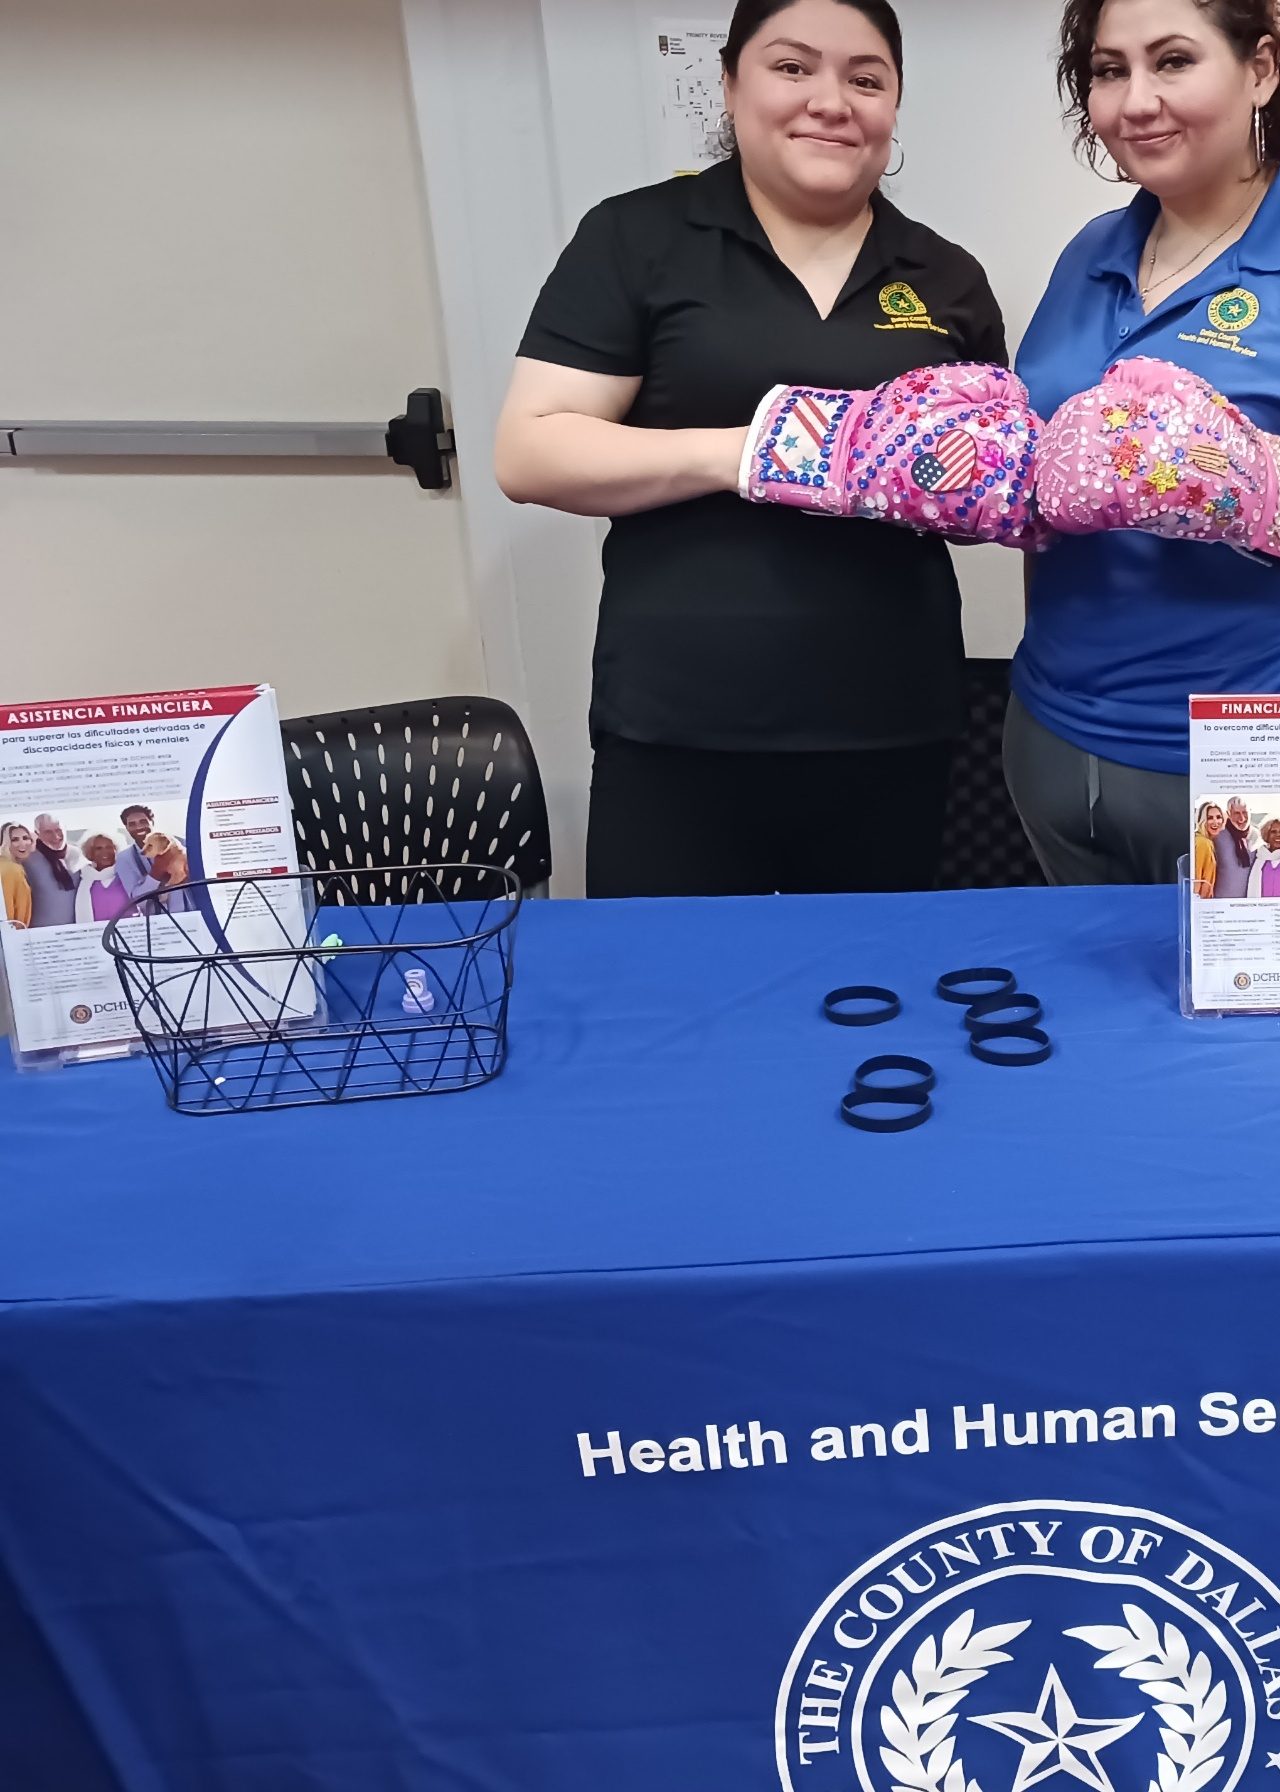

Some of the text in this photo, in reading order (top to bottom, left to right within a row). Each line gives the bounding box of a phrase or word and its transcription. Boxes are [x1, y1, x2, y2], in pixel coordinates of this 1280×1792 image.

[1177, 332, 1258, 358] Health and Human Services
[1218, 332, 1240, 344] County
[7, 699, 213, 724] ASISTENCIA FINANCIERA
[2, 722, 206, 746] para superar las dificultades derivadas de
[22, 741, 103, 754] discapacidades
[137, 738, 143, 747] y
[145, 735, 190, 745] mentales
[1250, 734, 1266, 742] and
[577, 1421, 788, 1477] Health
[811, 1409, 930, 1462] and
[953, 1403, 1176, 1449] Human
[798, 1659, 854, 1765] THE
[833, 1520, 1063, 1649] COUNTY
[1079, 1525, 1164, 1565] OF
